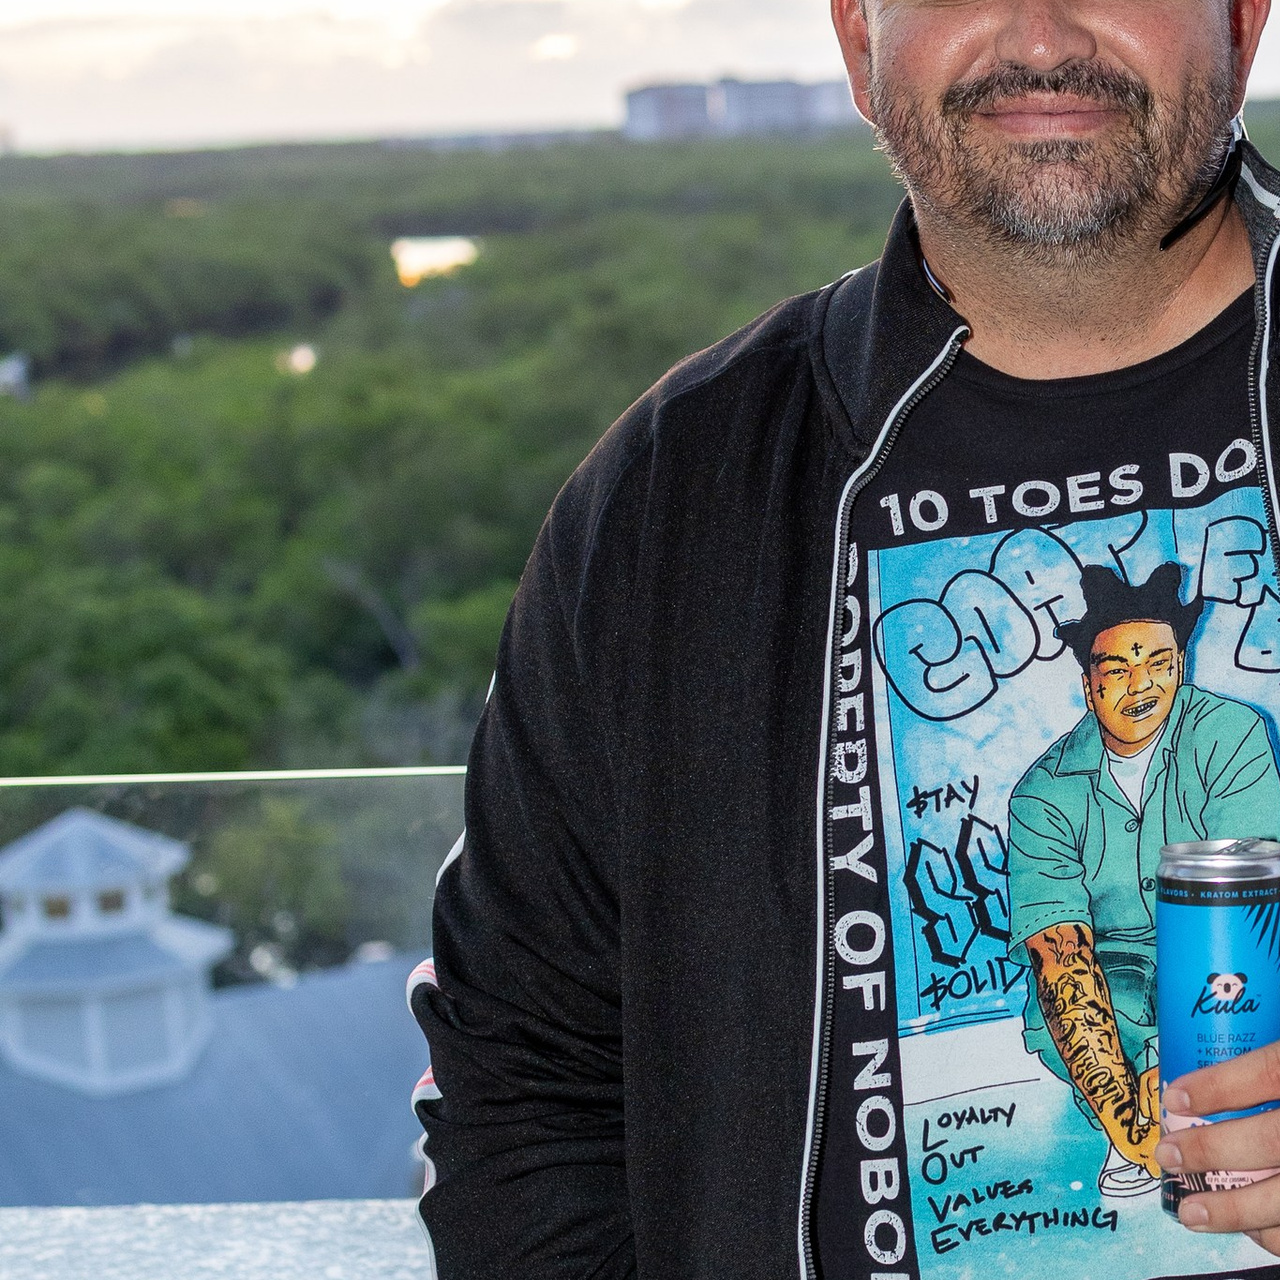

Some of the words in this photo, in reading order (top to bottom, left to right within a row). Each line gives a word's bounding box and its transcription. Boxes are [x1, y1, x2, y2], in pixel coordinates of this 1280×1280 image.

[879, 489, 949, 537] 10
[968, 463, 1144, 524] TOES
[1168, 438, 1259, 499] DO
[828, 541, 878, 884] OPERTY
[1200, 890, 1239, 899] KRATOM
[1242, 887, 1278, 898] EXTRACT
[833, 910, 887, 1013] OF
[1190, 986, 1261, 1018] Kula
[1197, 1033, 1225, 1043] BLUE
[1228, 1032, 1256, 1043] RAZZ
[1205, 1046, 1252, 1057] KRATOM
[922, 1102, 1017, 1153] LOYALTY
[921, 1145, 985, 1186] OUT
[927, 1179, 1034, 1224] VALUES
[930, 1207, 1119, 1255] EVERYTHING
